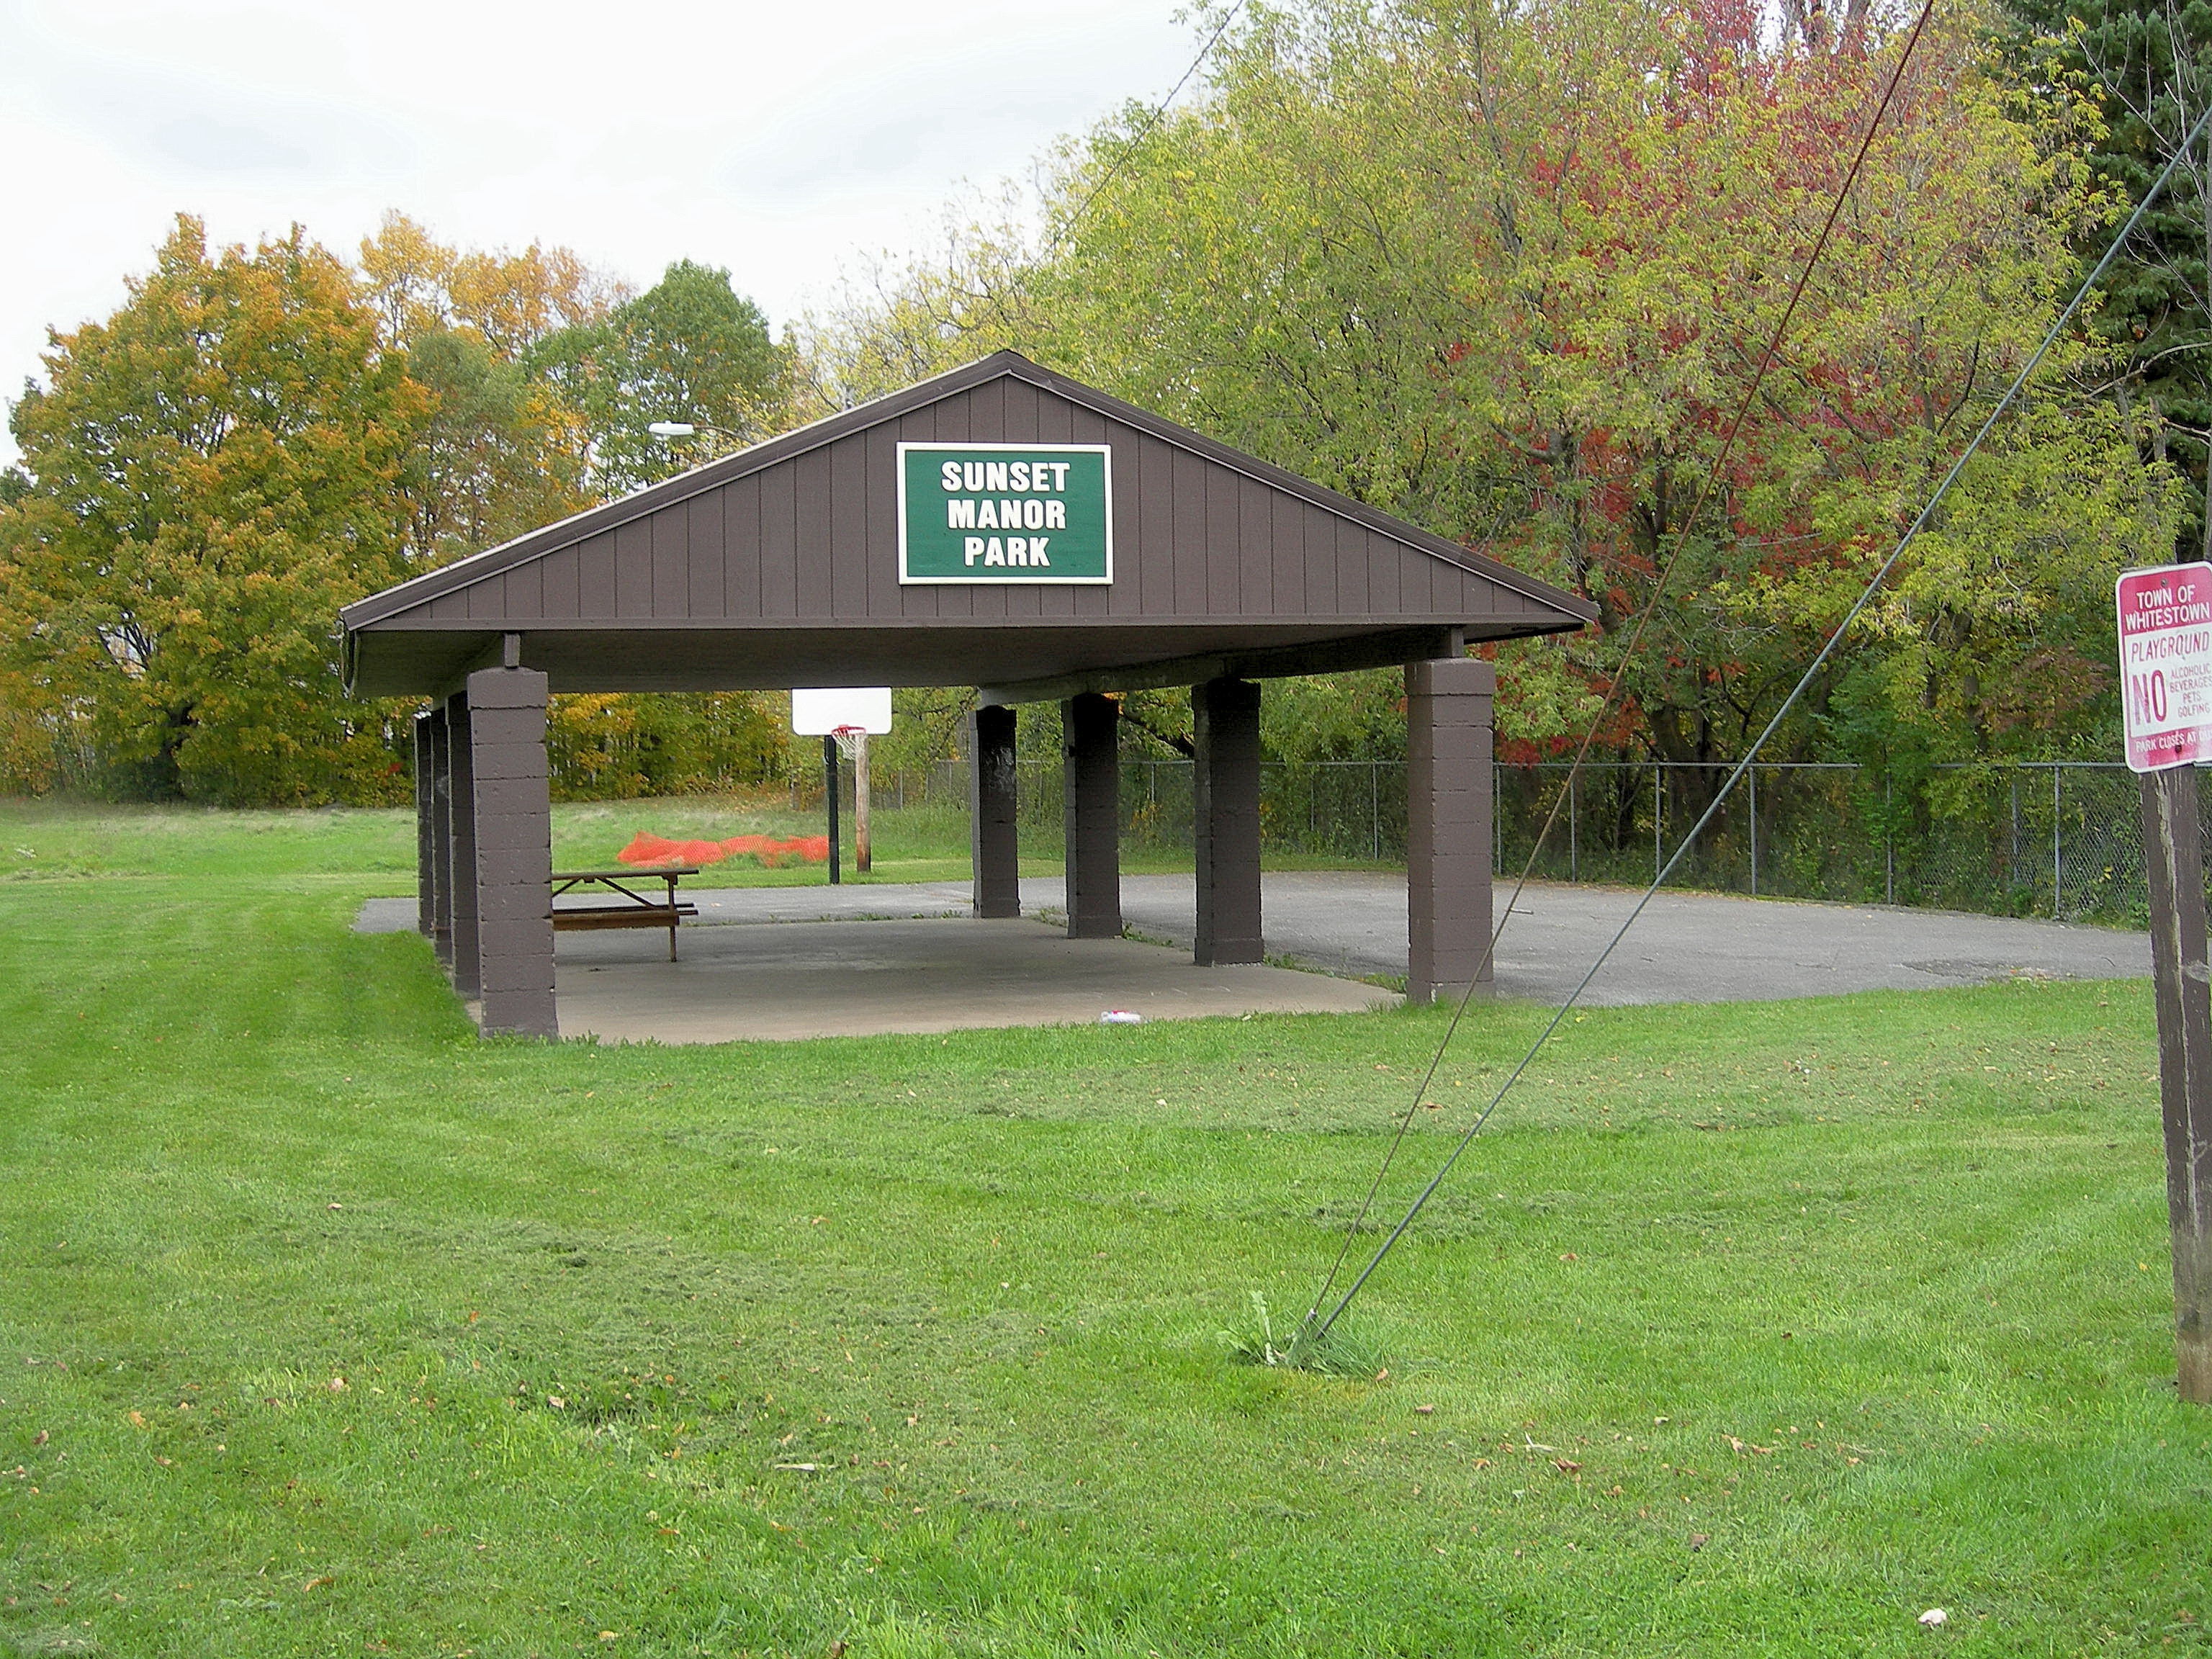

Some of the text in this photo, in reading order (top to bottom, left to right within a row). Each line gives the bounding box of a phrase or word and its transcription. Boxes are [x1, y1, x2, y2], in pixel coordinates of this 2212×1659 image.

[941, 461, 1071, 493] SUNSET
[947, 499, 1066, 530] MANOR
[964, 537, 1051, 567] PARK
[2136, 584, 2195, 609] TOWN OF
[2126, 601, 2211, 631] WHITESTOWN
[2131, 631, 2210, 662] PLAYGROUND
[2170, 675, 2212, 693] BEVERAGES
[2171, 663, 2211, 679] ALCOHOLIC
[2133, 670, 2167, 725] NO
[2177, 703, 2211, 718] GOLFING
[2183, 691, 2201, 703] PETS
[2136, 739, 2157, 752] PARK
[2159, 732, 2185, 749] CLOSES
[2187, 732, 2196, 744] AT
